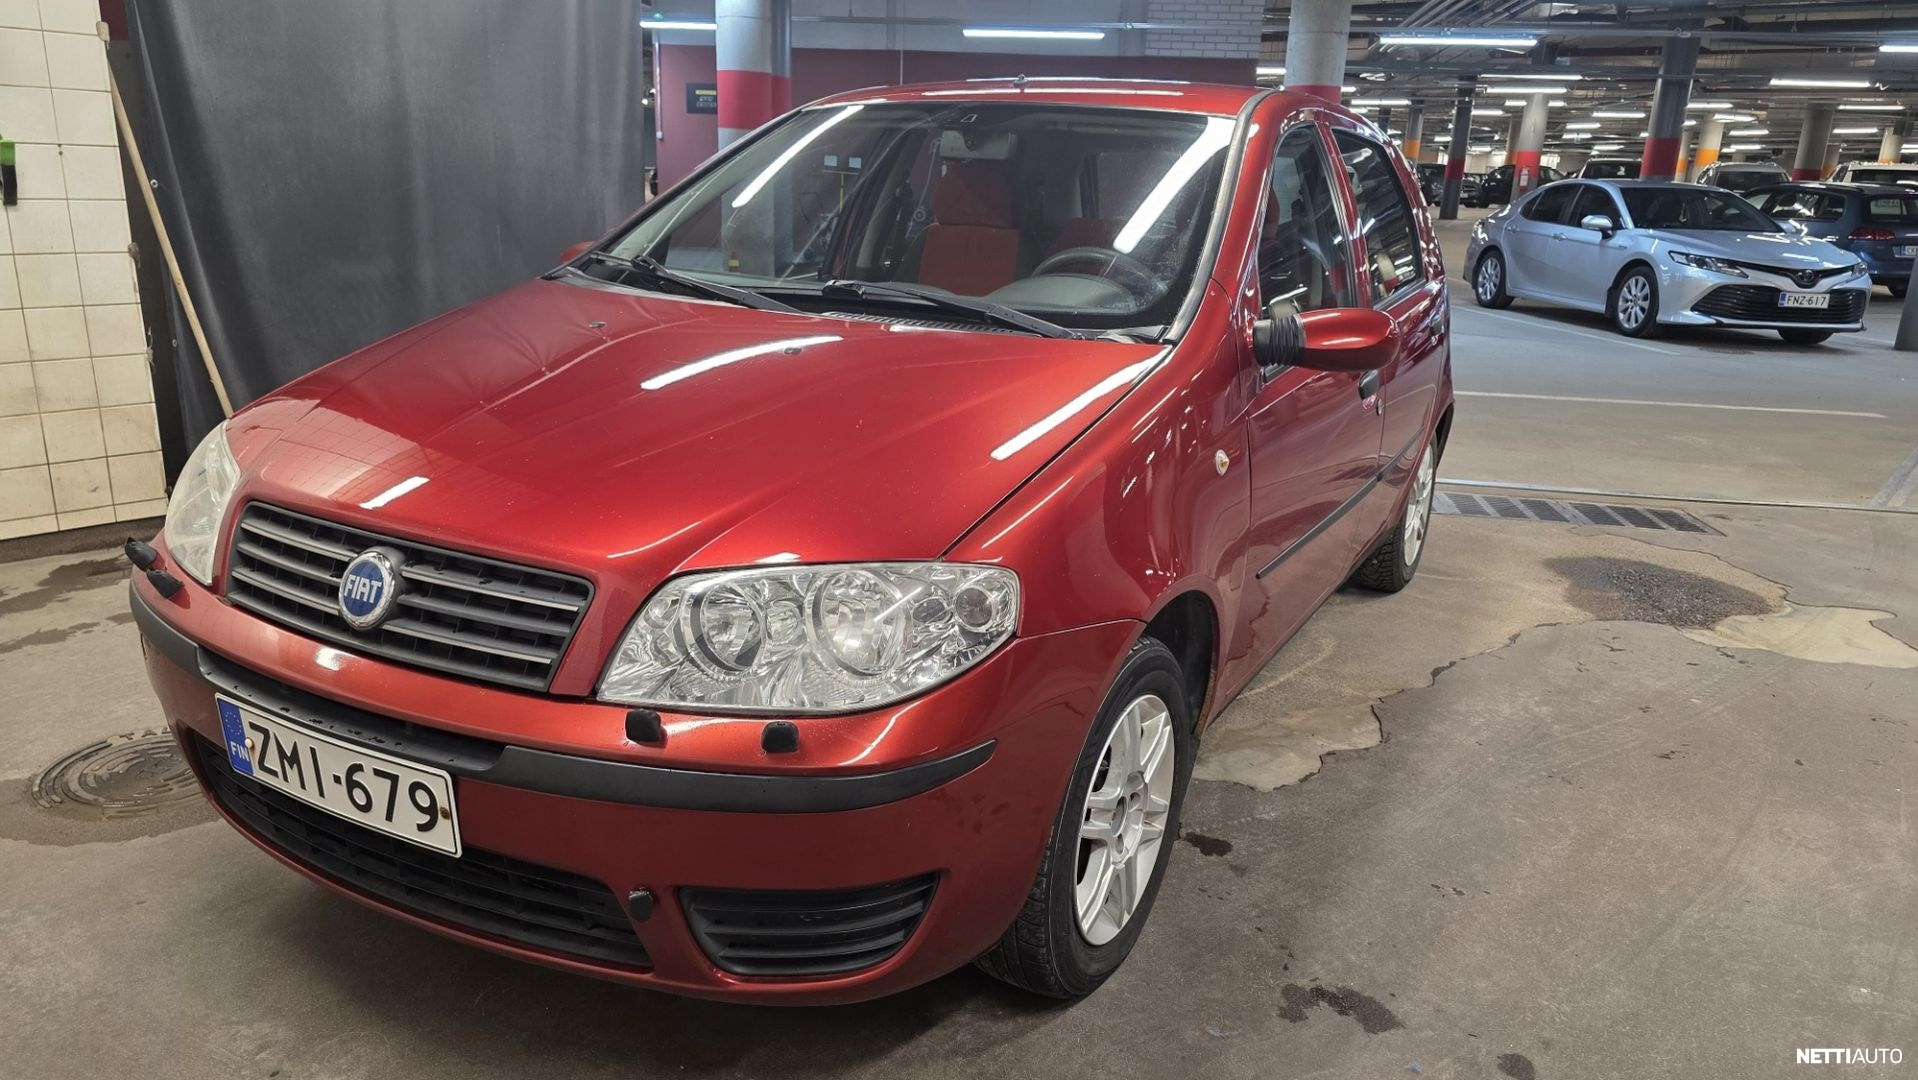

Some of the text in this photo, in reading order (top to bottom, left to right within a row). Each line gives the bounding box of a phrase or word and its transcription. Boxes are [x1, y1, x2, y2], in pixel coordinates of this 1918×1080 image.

[1787, 295, 1827, 306] FNZ-617
[344, 574, 382, 604] FIAT
[230, 741, 250, 762] FIN
[248, 720, 439, 832] ZMI-679
